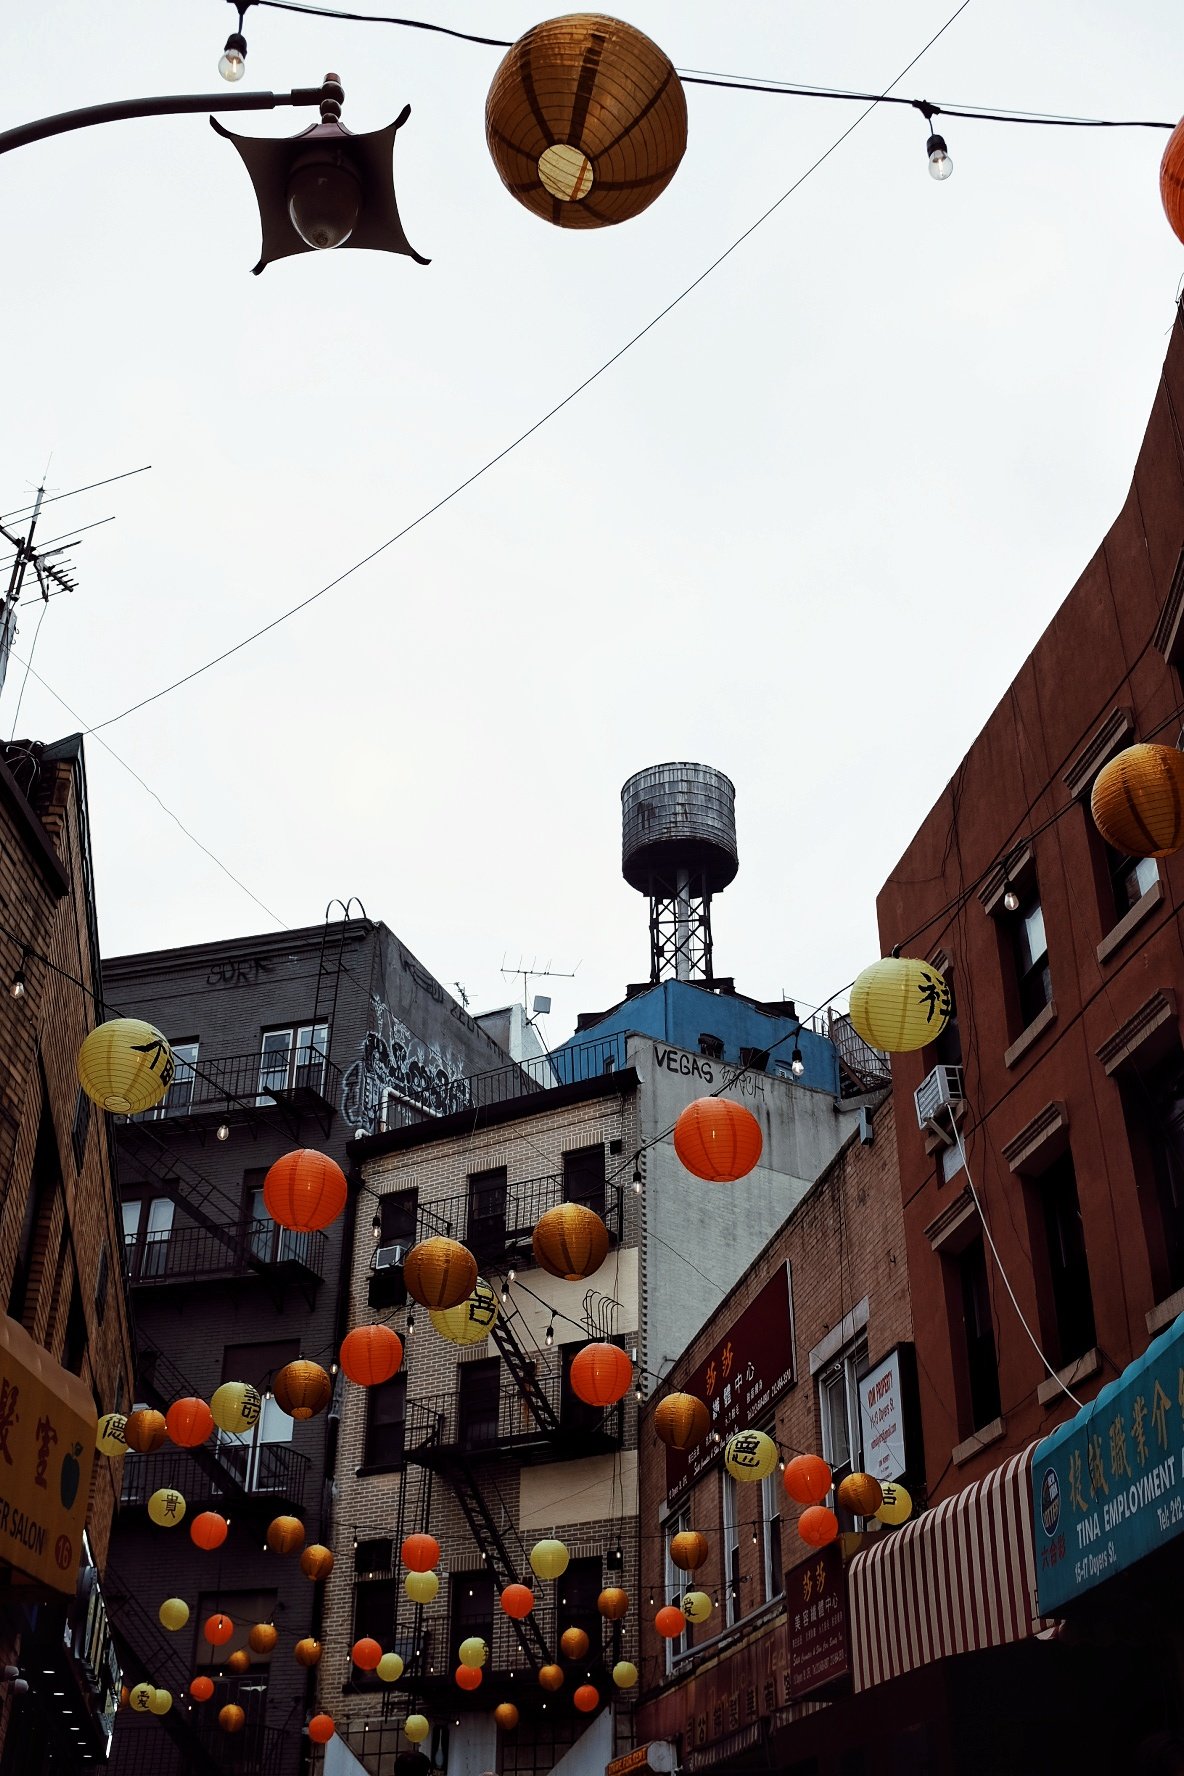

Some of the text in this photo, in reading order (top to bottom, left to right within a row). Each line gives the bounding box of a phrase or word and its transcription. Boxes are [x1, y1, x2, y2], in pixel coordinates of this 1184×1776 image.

[654, 1046, 713, 1083] VEGAS
[161, 1492, 183, 1519] 貴
[882, 1486, 897, 1506] 吉
[1076, 1517, 1101, 1549] TINA
[1103, 1455, 1176, 1532] EMPLOYMENT
[10, 1508, 46, 1556] SALON
[58, 1538, 70, 1567] 16
[1088, 1547, 1107, 1576] Doyers
